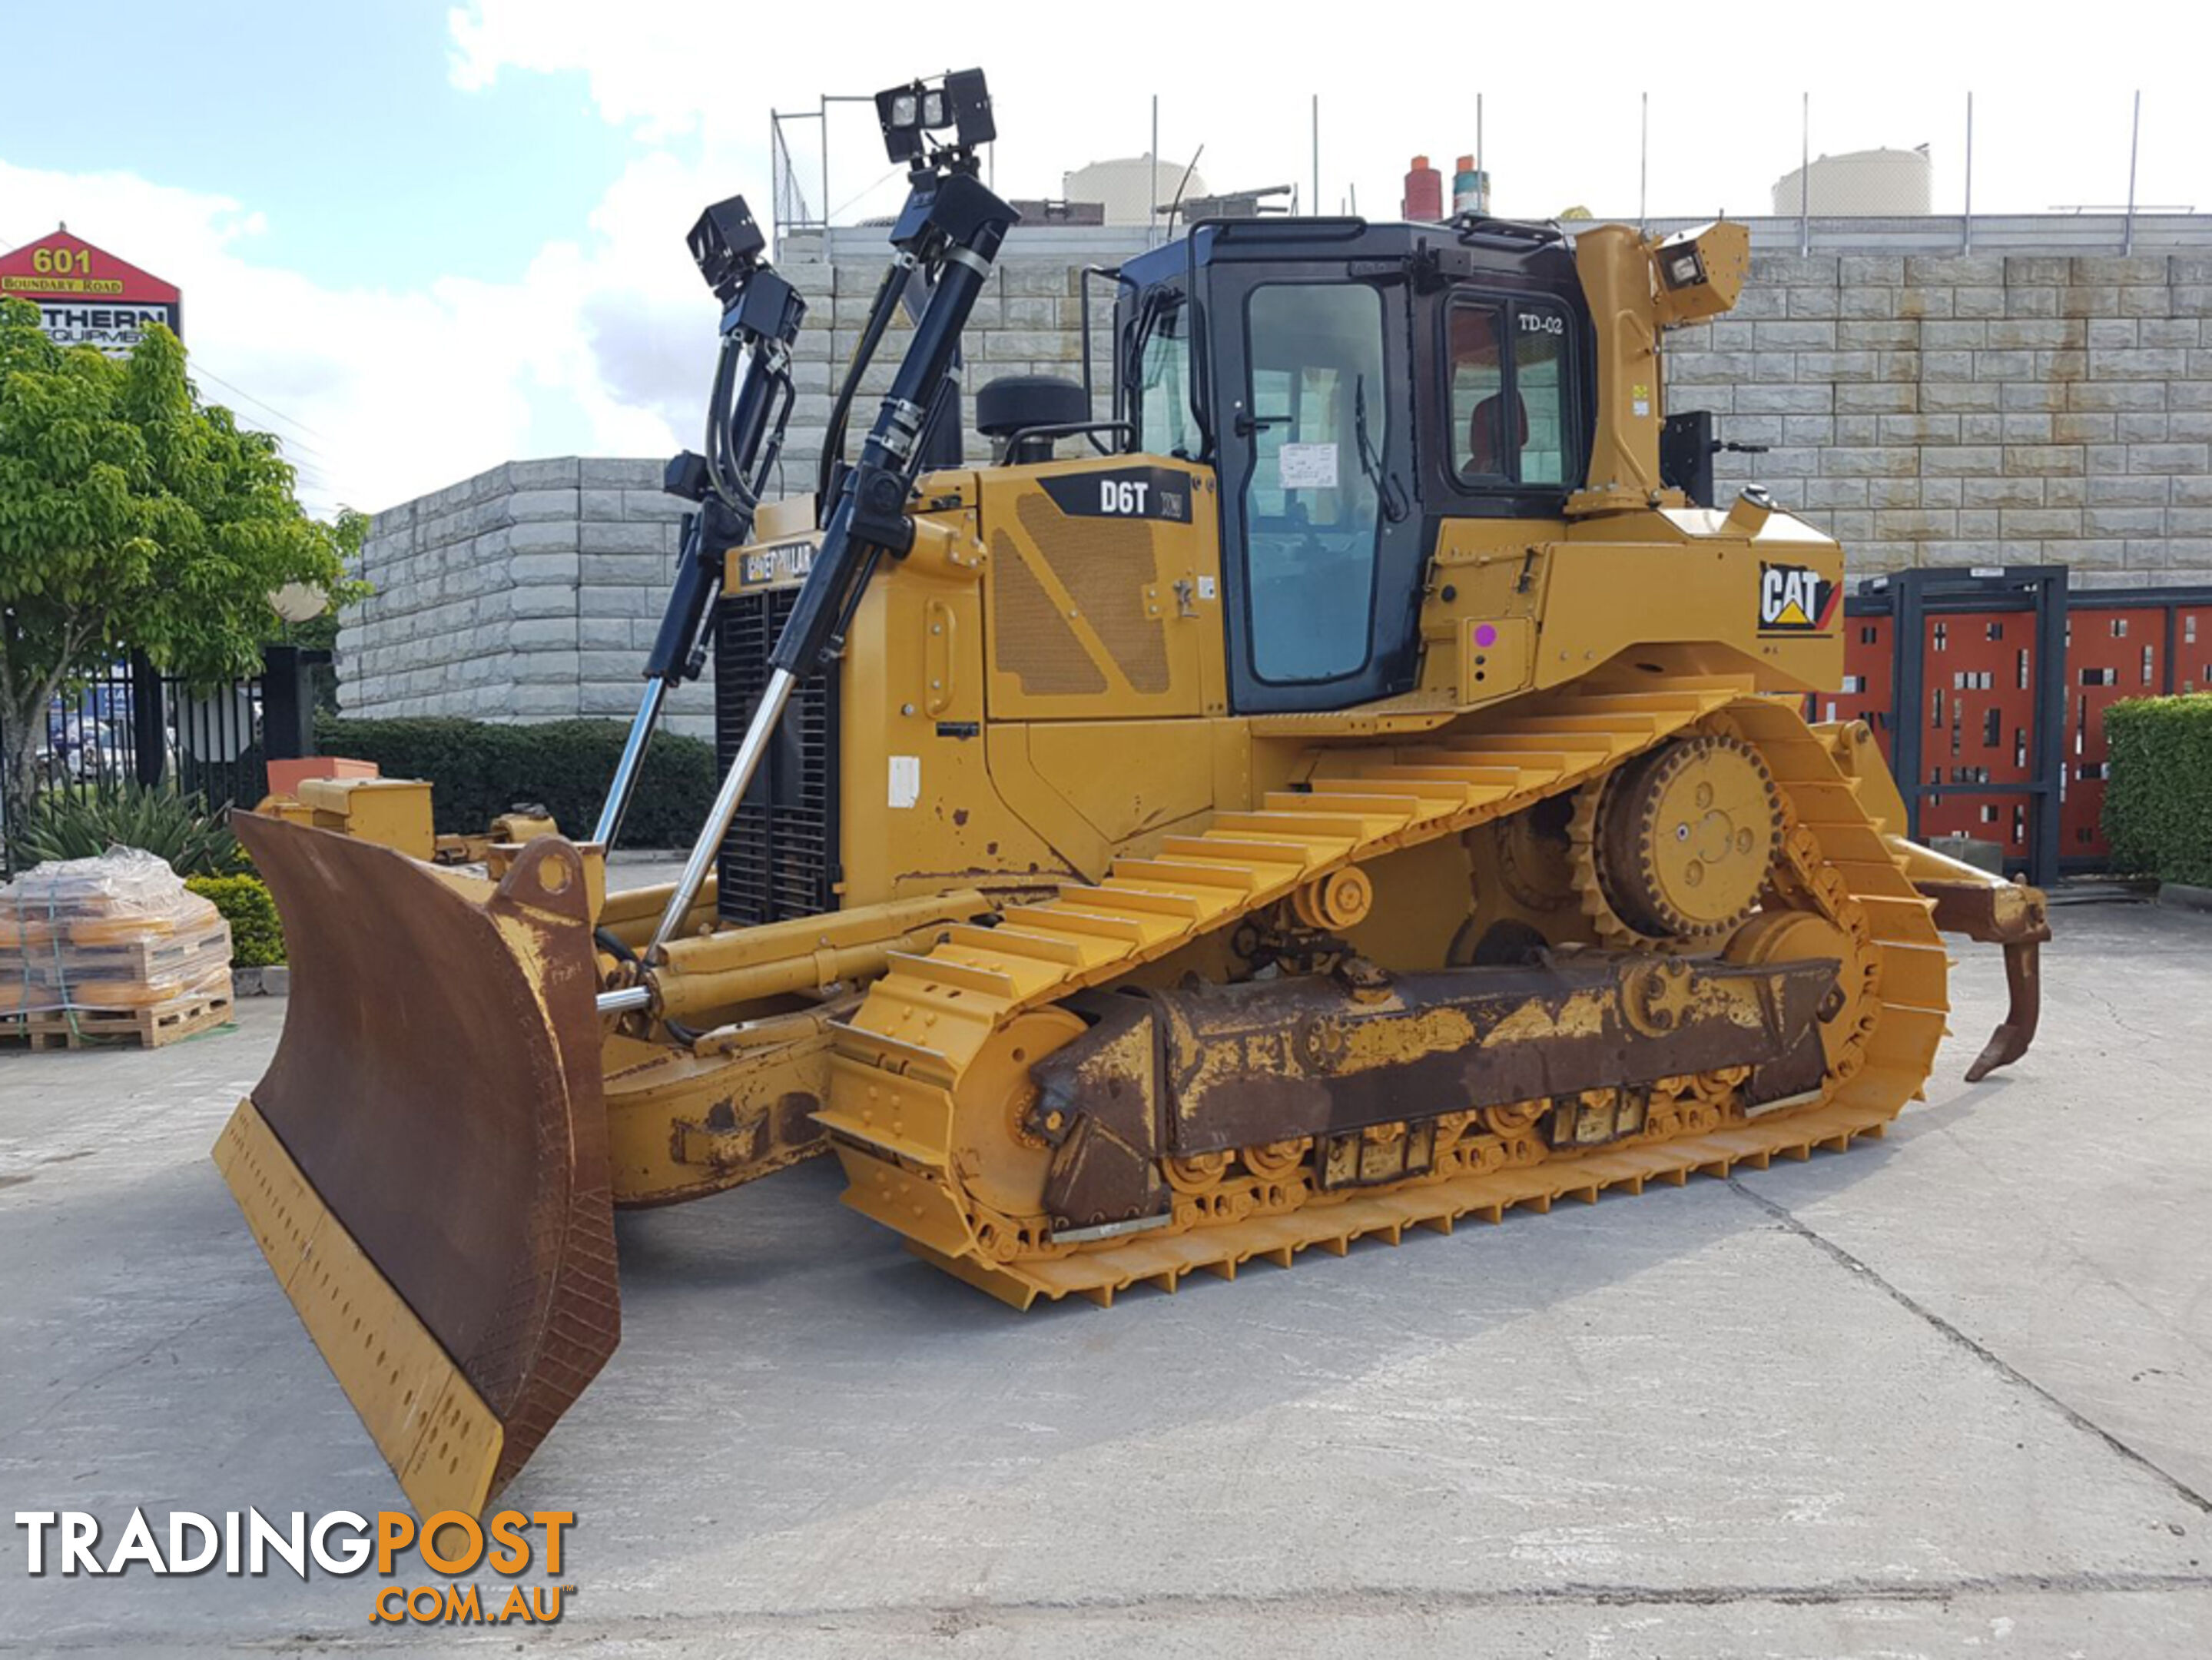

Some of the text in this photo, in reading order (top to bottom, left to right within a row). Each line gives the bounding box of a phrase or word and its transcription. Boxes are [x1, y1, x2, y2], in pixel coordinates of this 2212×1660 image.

[32, 247, 91, 274] 601
[1517, 313, 1564, 334] TD-02
[1100, 480, 1149, 514] D6T
[1762, 569, 1820, 622] CAT
